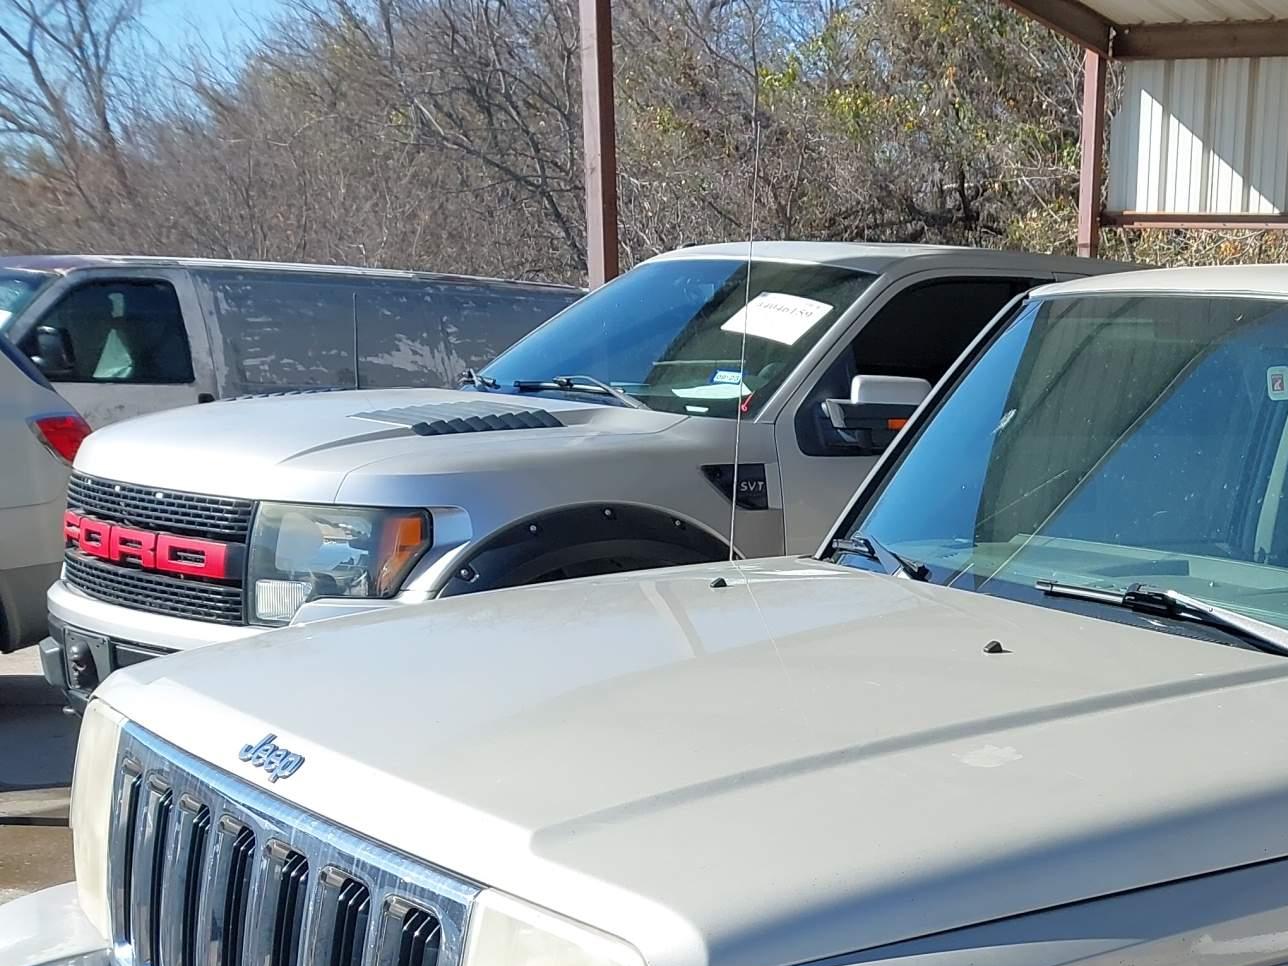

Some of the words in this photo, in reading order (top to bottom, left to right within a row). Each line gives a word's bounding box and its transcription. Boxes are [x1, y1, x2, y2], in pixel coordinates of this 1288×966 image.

[740, 480, 764, 491] SVT
[64, 511, 227, 578] FORD
[239, 733, 305, 784] Jeep
